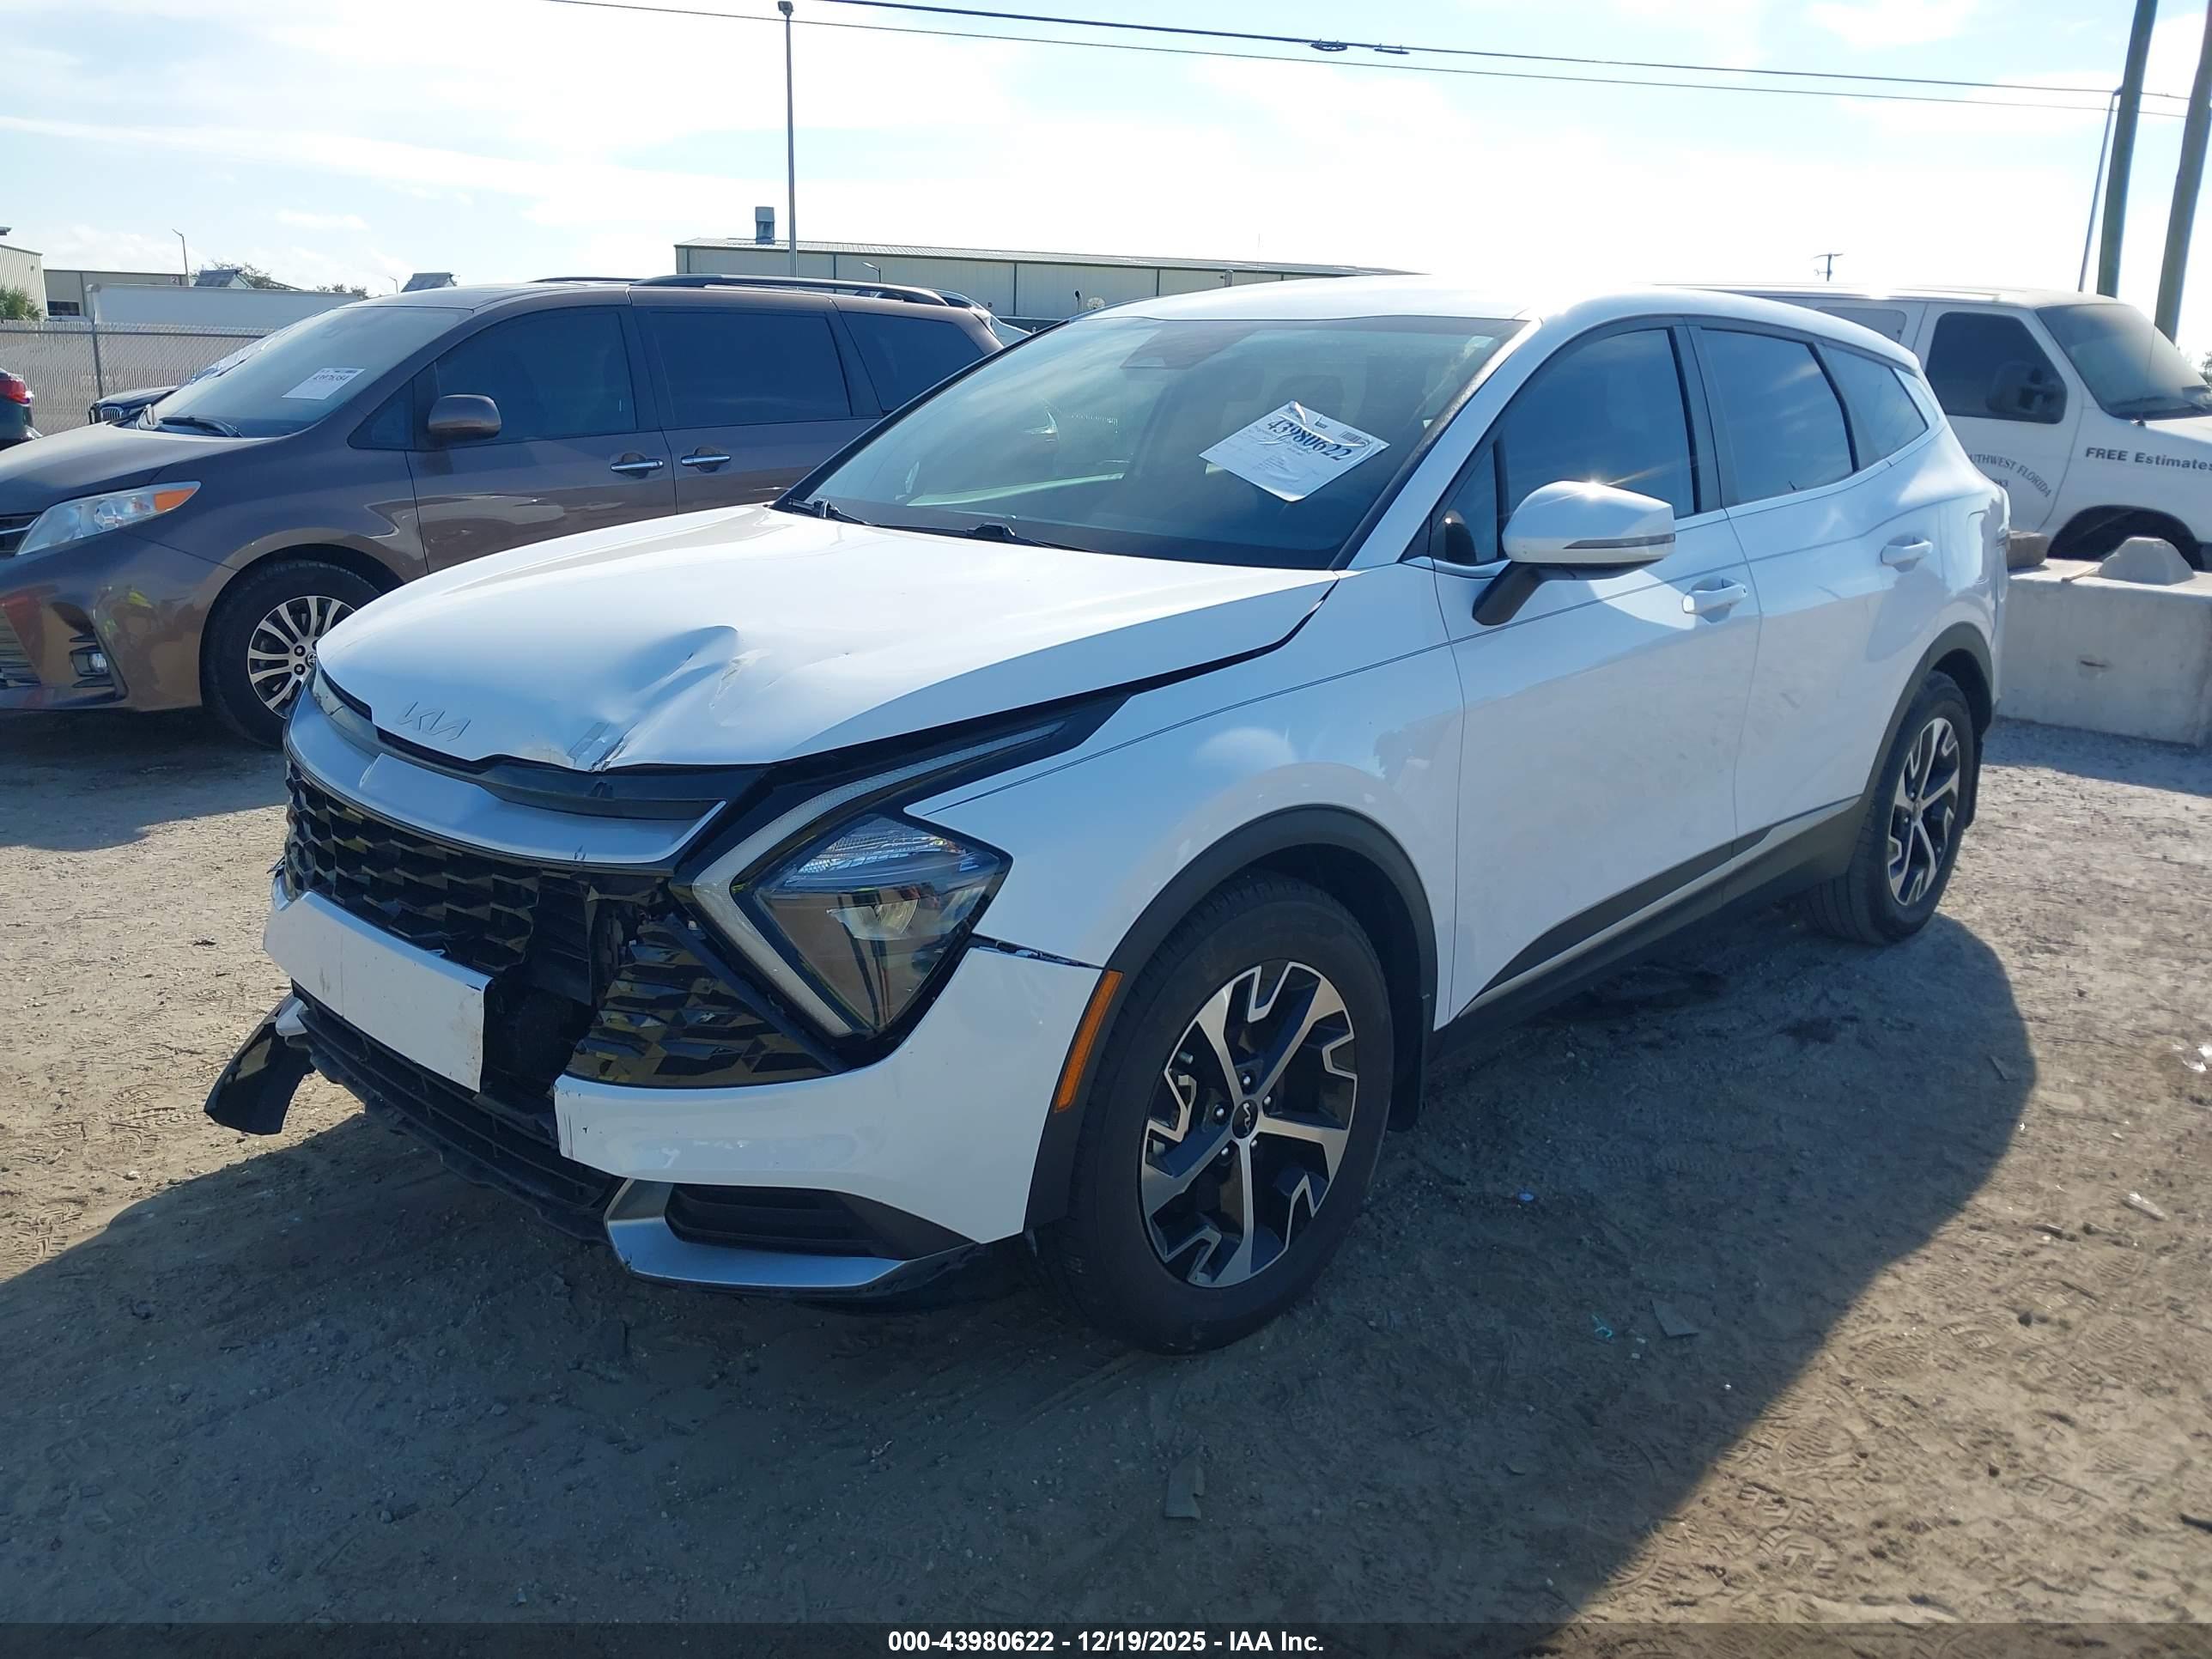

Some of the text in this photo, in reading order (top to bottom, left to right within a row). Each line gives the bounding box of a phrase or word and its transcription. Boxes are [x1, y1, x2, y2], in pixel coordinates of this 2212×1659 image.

[1267, 416, 1353, 461] 43980622
[2085, 447, 2129, 462] FREE
[2016, 465, 2052, 498] FLORIDA
